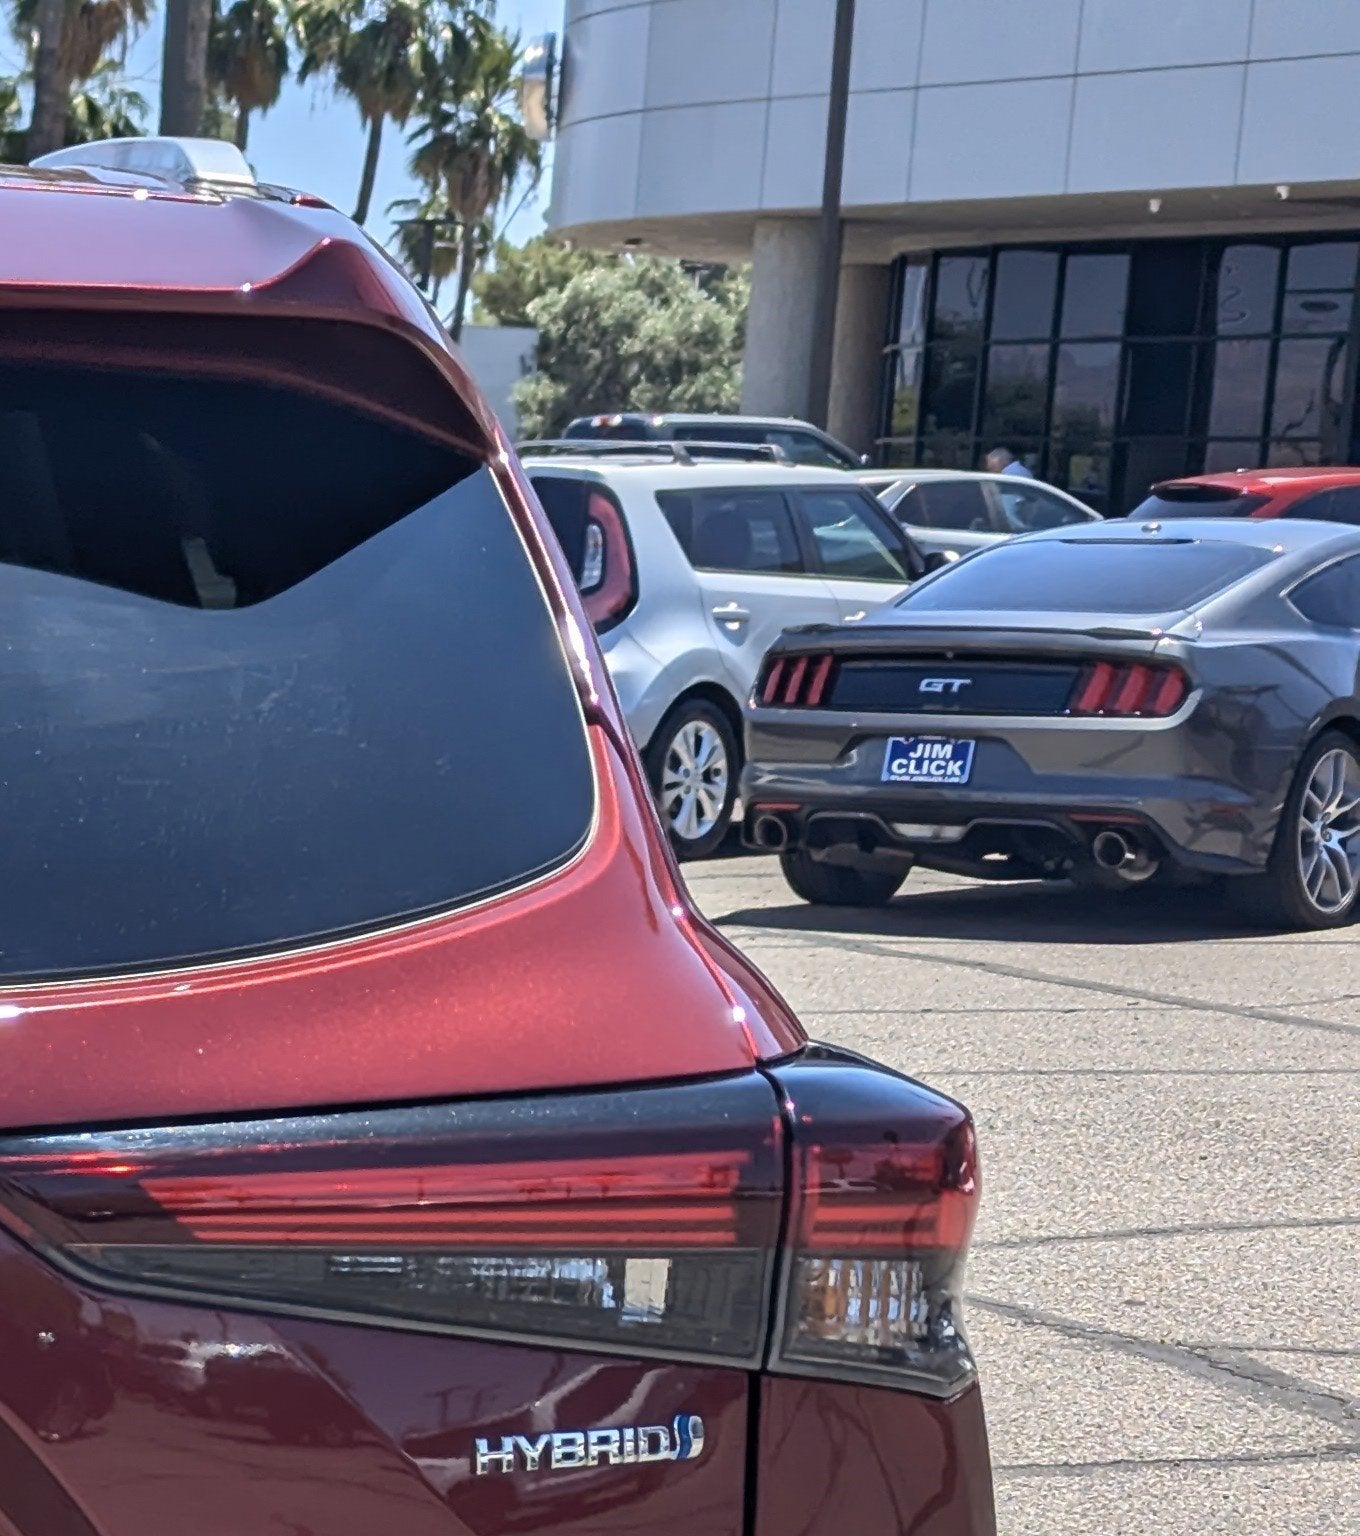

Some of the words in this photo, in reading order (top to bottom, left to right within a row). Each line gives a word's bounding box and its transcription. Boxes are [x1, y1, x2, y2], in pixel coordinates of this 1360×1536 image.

[919, 678, 971, 692] GT
[908, 743, 953, 759] JIM
[891, 758, 963, 776] CLICK
[475, 1425, 672, 1475] HYBRID
